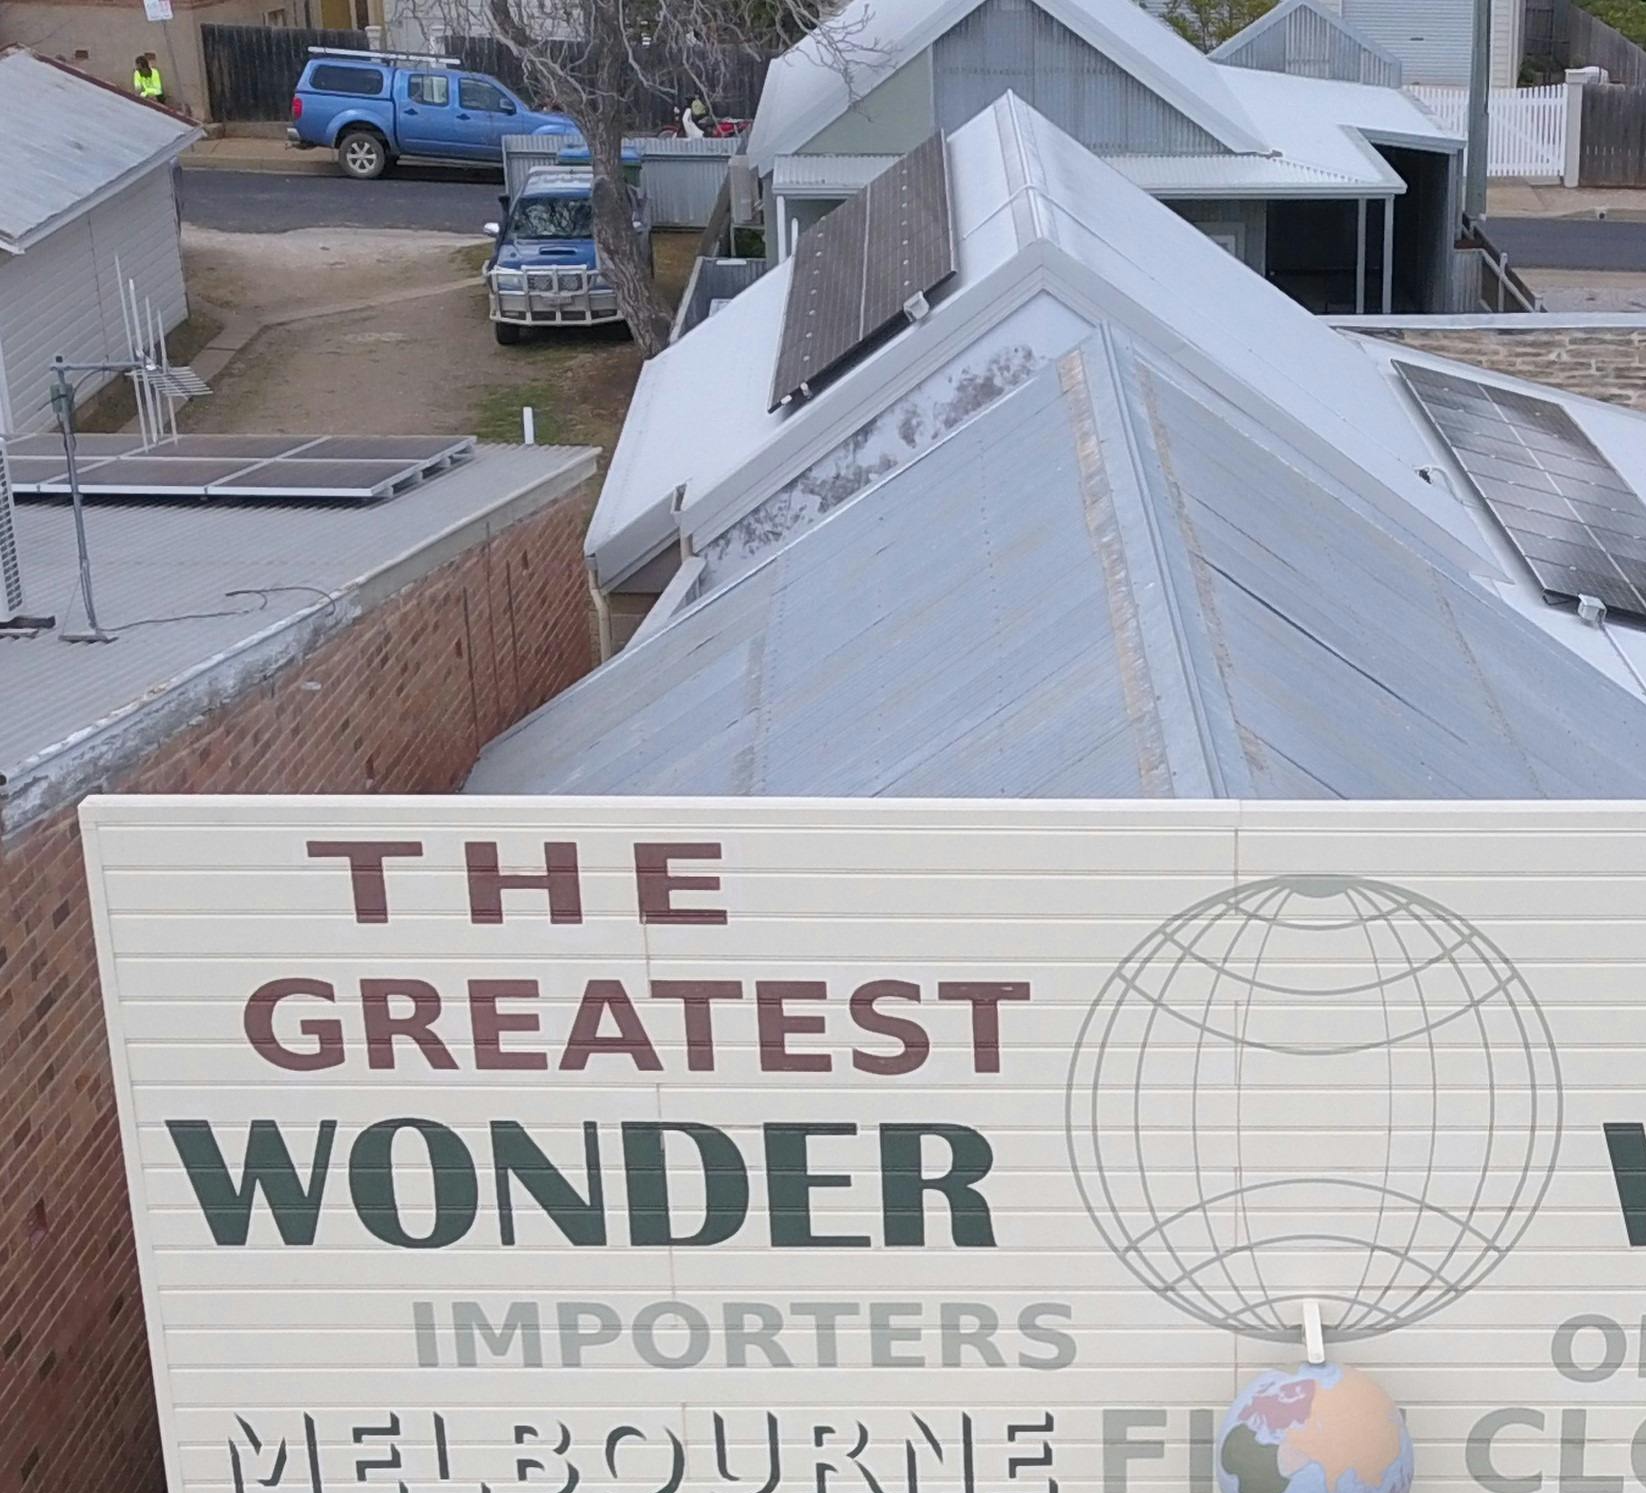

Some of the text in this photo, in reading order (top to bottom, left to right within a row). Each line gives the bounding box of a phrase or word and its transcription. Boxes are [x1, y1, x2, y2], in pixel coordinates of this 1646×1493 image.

[307, 841, 727, 925] THE
[244, 978, 1030, 1075] GREATEST
[166, 1118, 996, 1248] WONDER
[413, 1301, 1076, 1370] IMPORTERS
